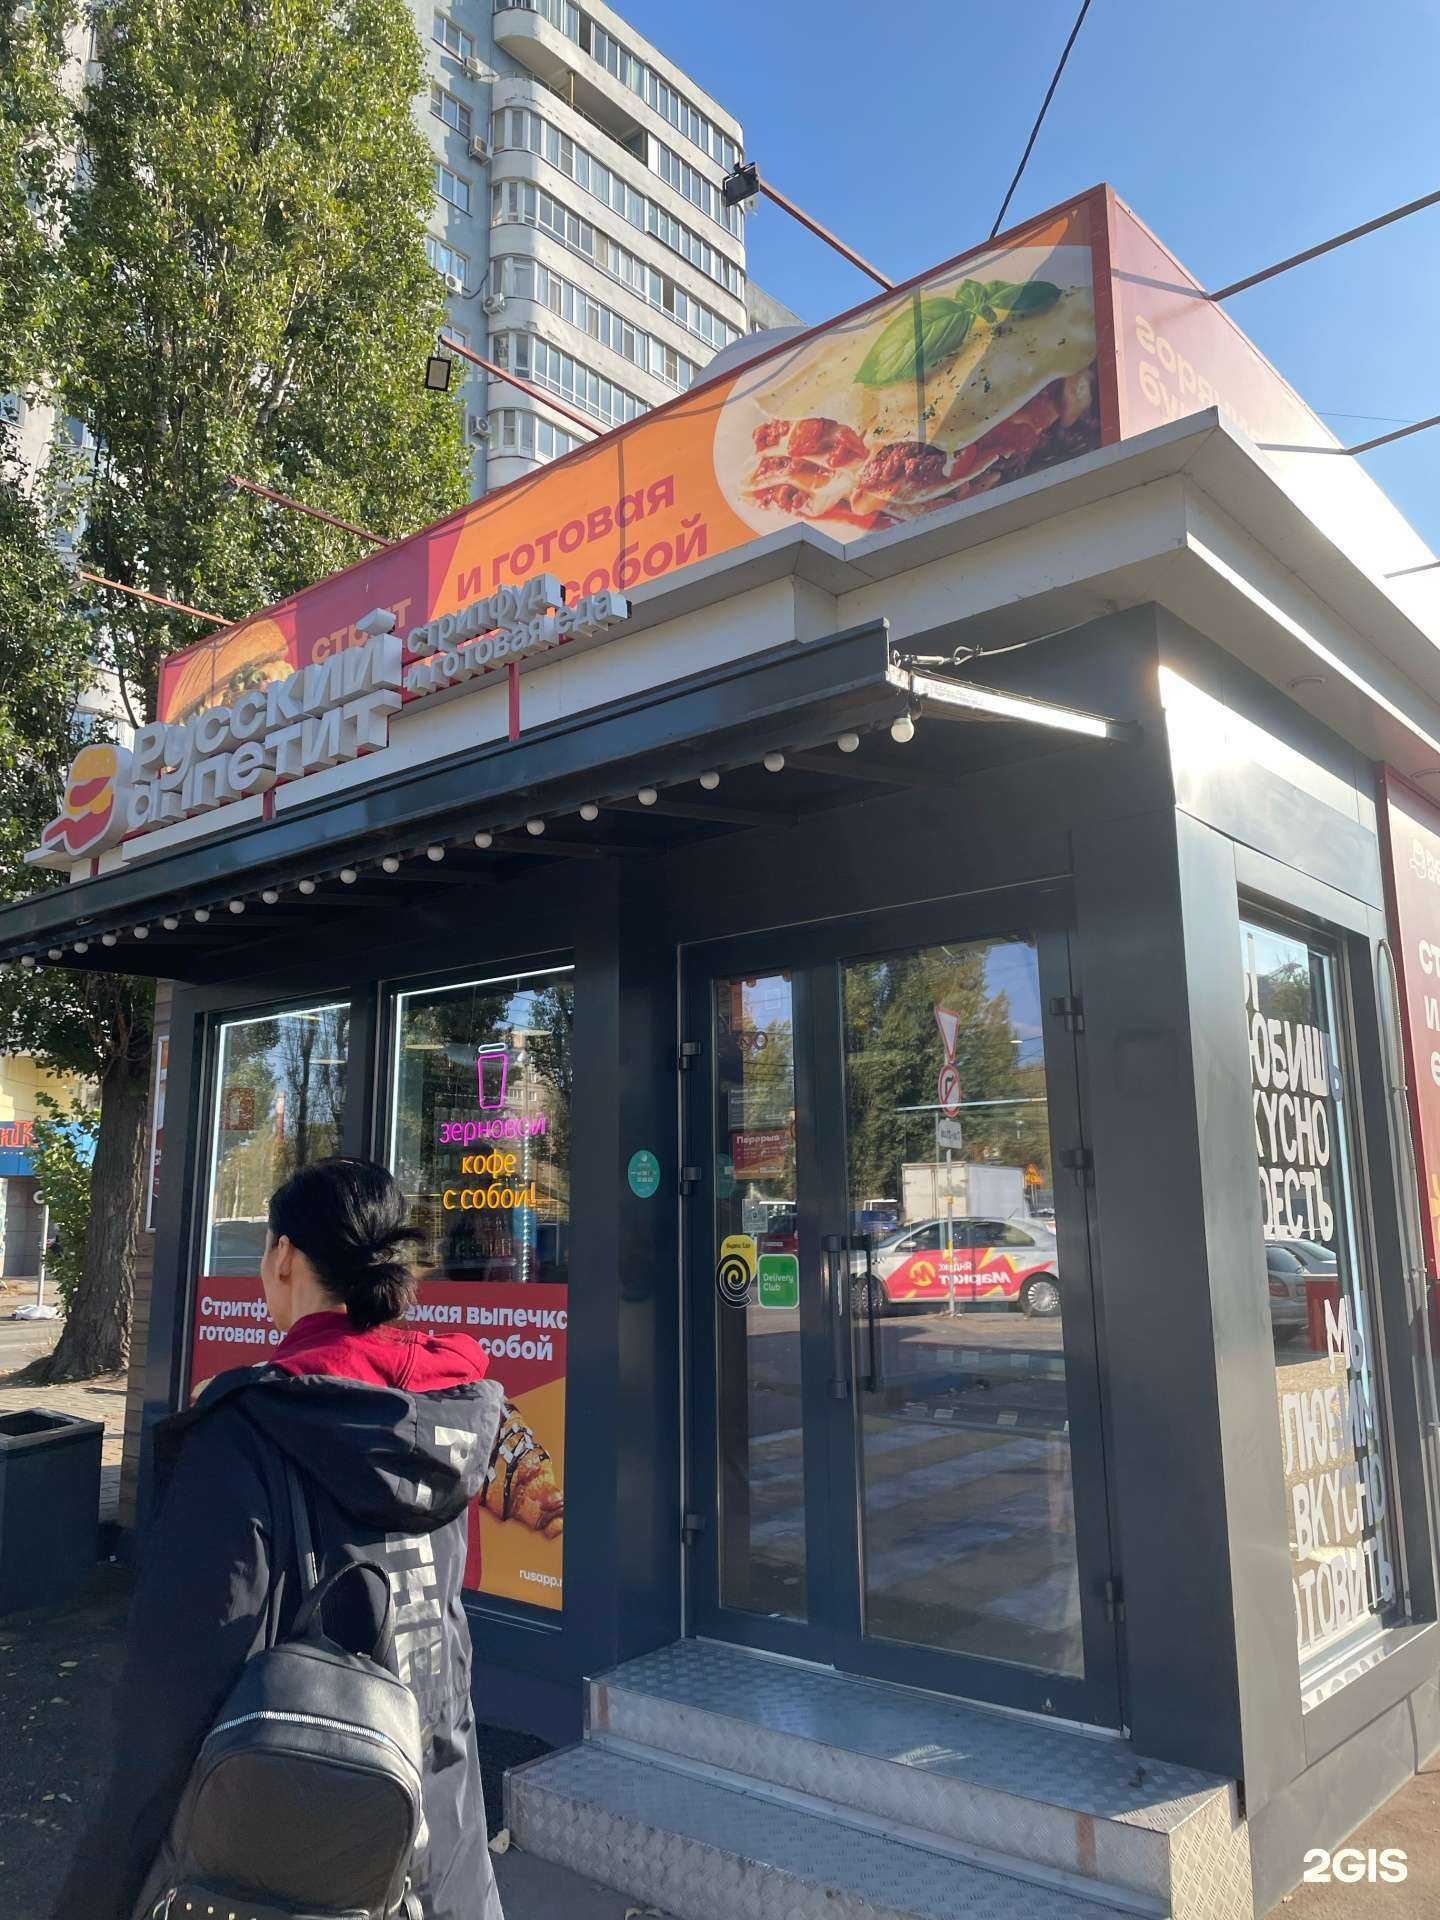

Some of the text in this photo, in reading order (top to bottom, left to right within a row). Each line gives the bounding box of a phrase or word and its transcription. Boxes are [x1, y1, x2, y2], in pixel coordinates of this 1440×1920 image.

[457, 474, 675, 602] и готовая
[561, 513, 708, 608] собой
[312, 597, 412, 664] стрт
[407, 573, 561, 654] стритфуд
[431, 615, 556, 684] готовая
[1248, 1011, 1343, 1102] ЮБИШЬ
[439, 1112, 547, 1147] зерновой
[1252, 1089, 1330, 1167] КУСНО
[443, 1182, 537, 1210] с собой!
[461, 1148, 517, 1179] кофе
[1258, 1167, 1334, 1242] ОЕСТЬ
[201, 1296, 274, 1323] Стритф
[763, 1273, 794, 1284] Delivery
[763, 1282, 782, 1292] Club
[199, 1325, 266, 1345] готовая
[404, 1303, 463, 1325] ежая
[1292, 1453, 1385, 1561] ВКУСНО
